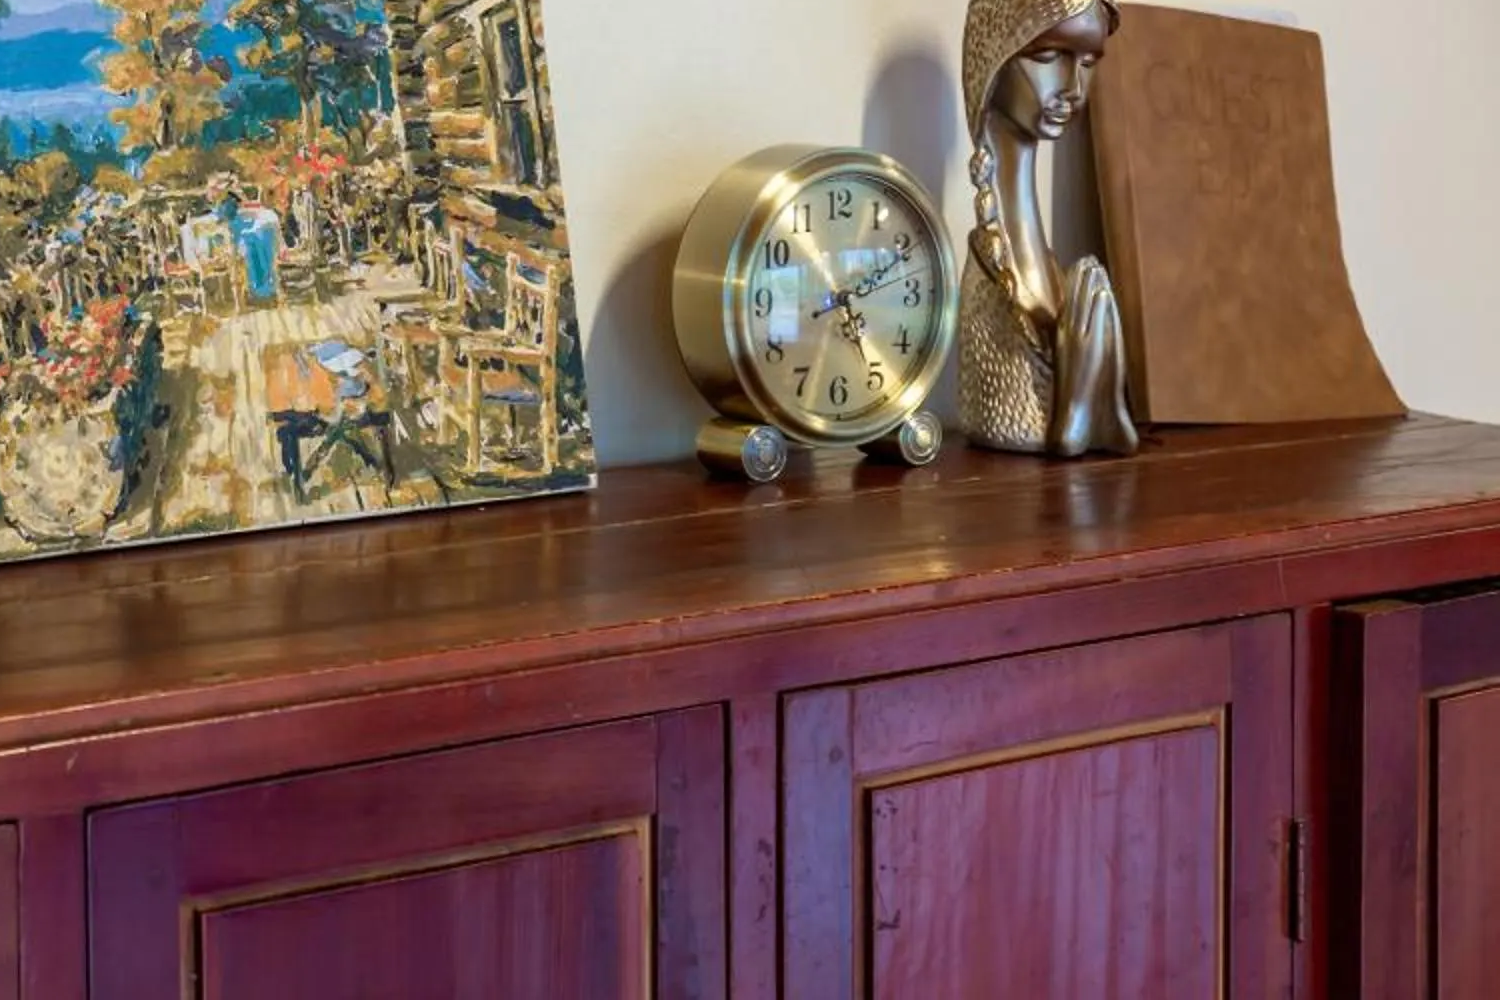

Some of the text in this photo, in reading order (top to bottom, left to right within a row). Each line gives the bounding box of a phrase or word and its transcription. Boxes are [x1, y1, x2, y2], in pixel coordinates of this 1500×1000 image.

[791, 203, 812, 234] 11
[827, 188, 853, 221] 12
[871, 201, 883, 231] 1
[764, 238, 790, 270] 10
[894, 232, 912, 263] 2
[754, 287, 773, 319] 9
[903, 278, 921, 307] 3
[765, 336, 784, 366] 8
[892, 324, 912, 355] 4
[793, 365, 810, 397] 7
[829, 374, 848, 407] 6
[866, 361, 885, 391] 5
